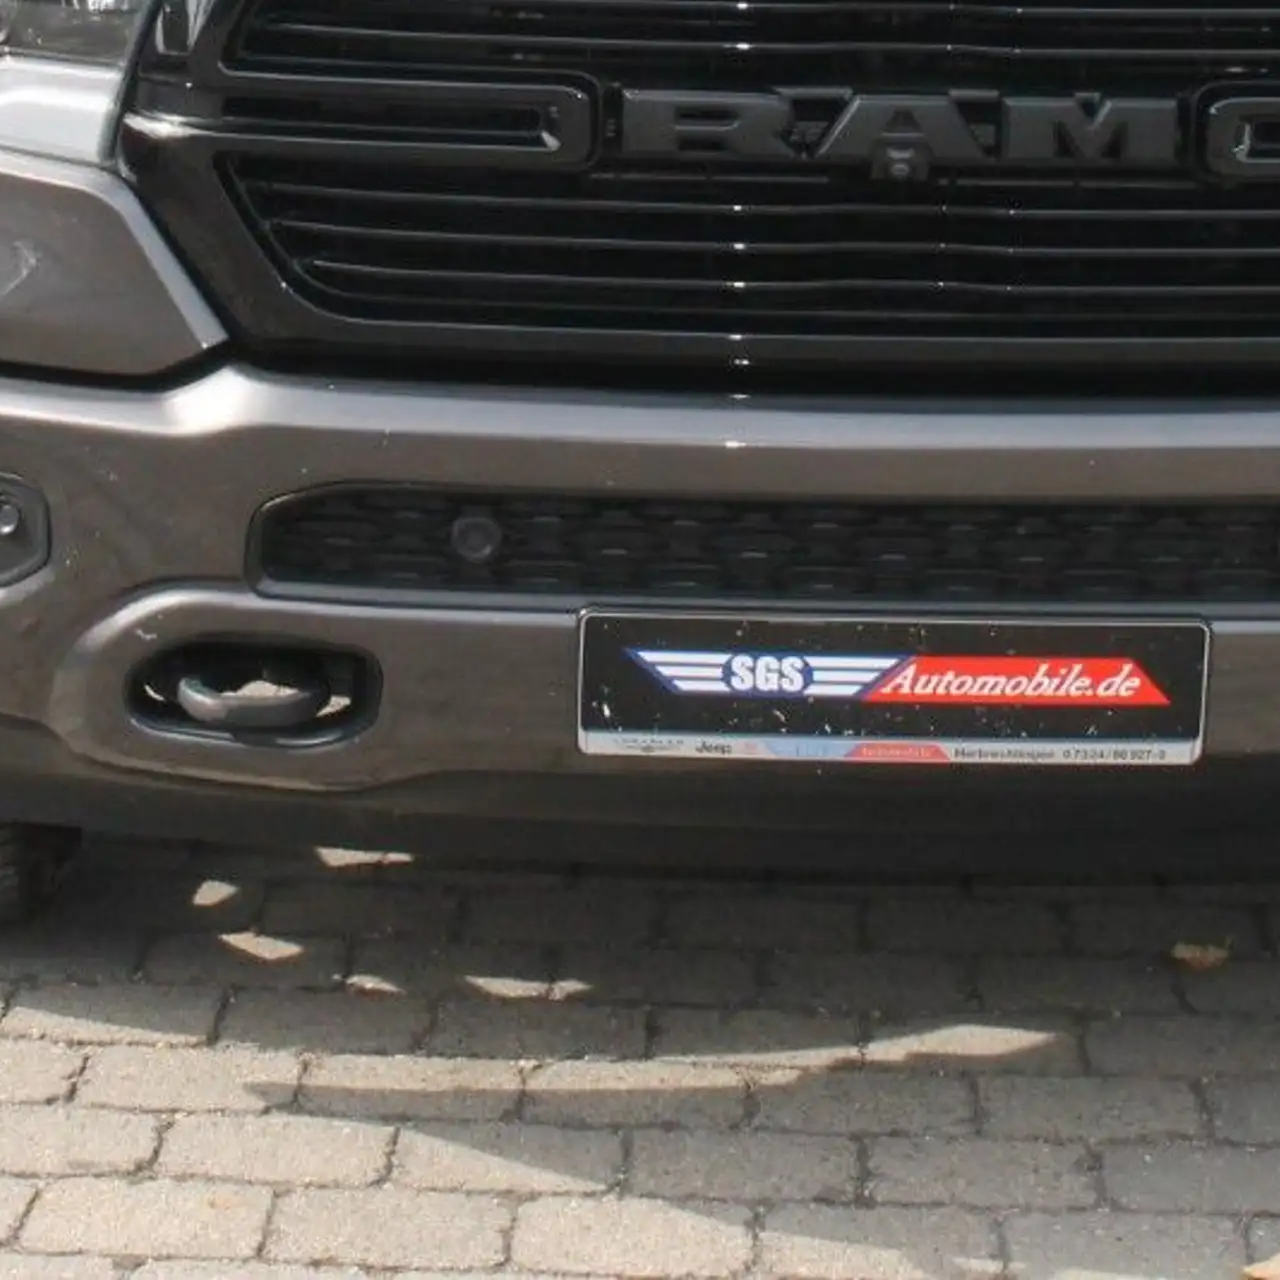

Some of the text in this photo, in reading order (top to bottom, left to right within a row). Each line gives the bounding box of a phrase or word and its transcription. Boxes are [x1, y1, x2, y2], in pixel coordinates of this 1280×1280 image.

[621, 87, 1177, 160] RAM
[730, 655, 805, 693] SGS
[882, 662, 1141, 698] Automobile.de
